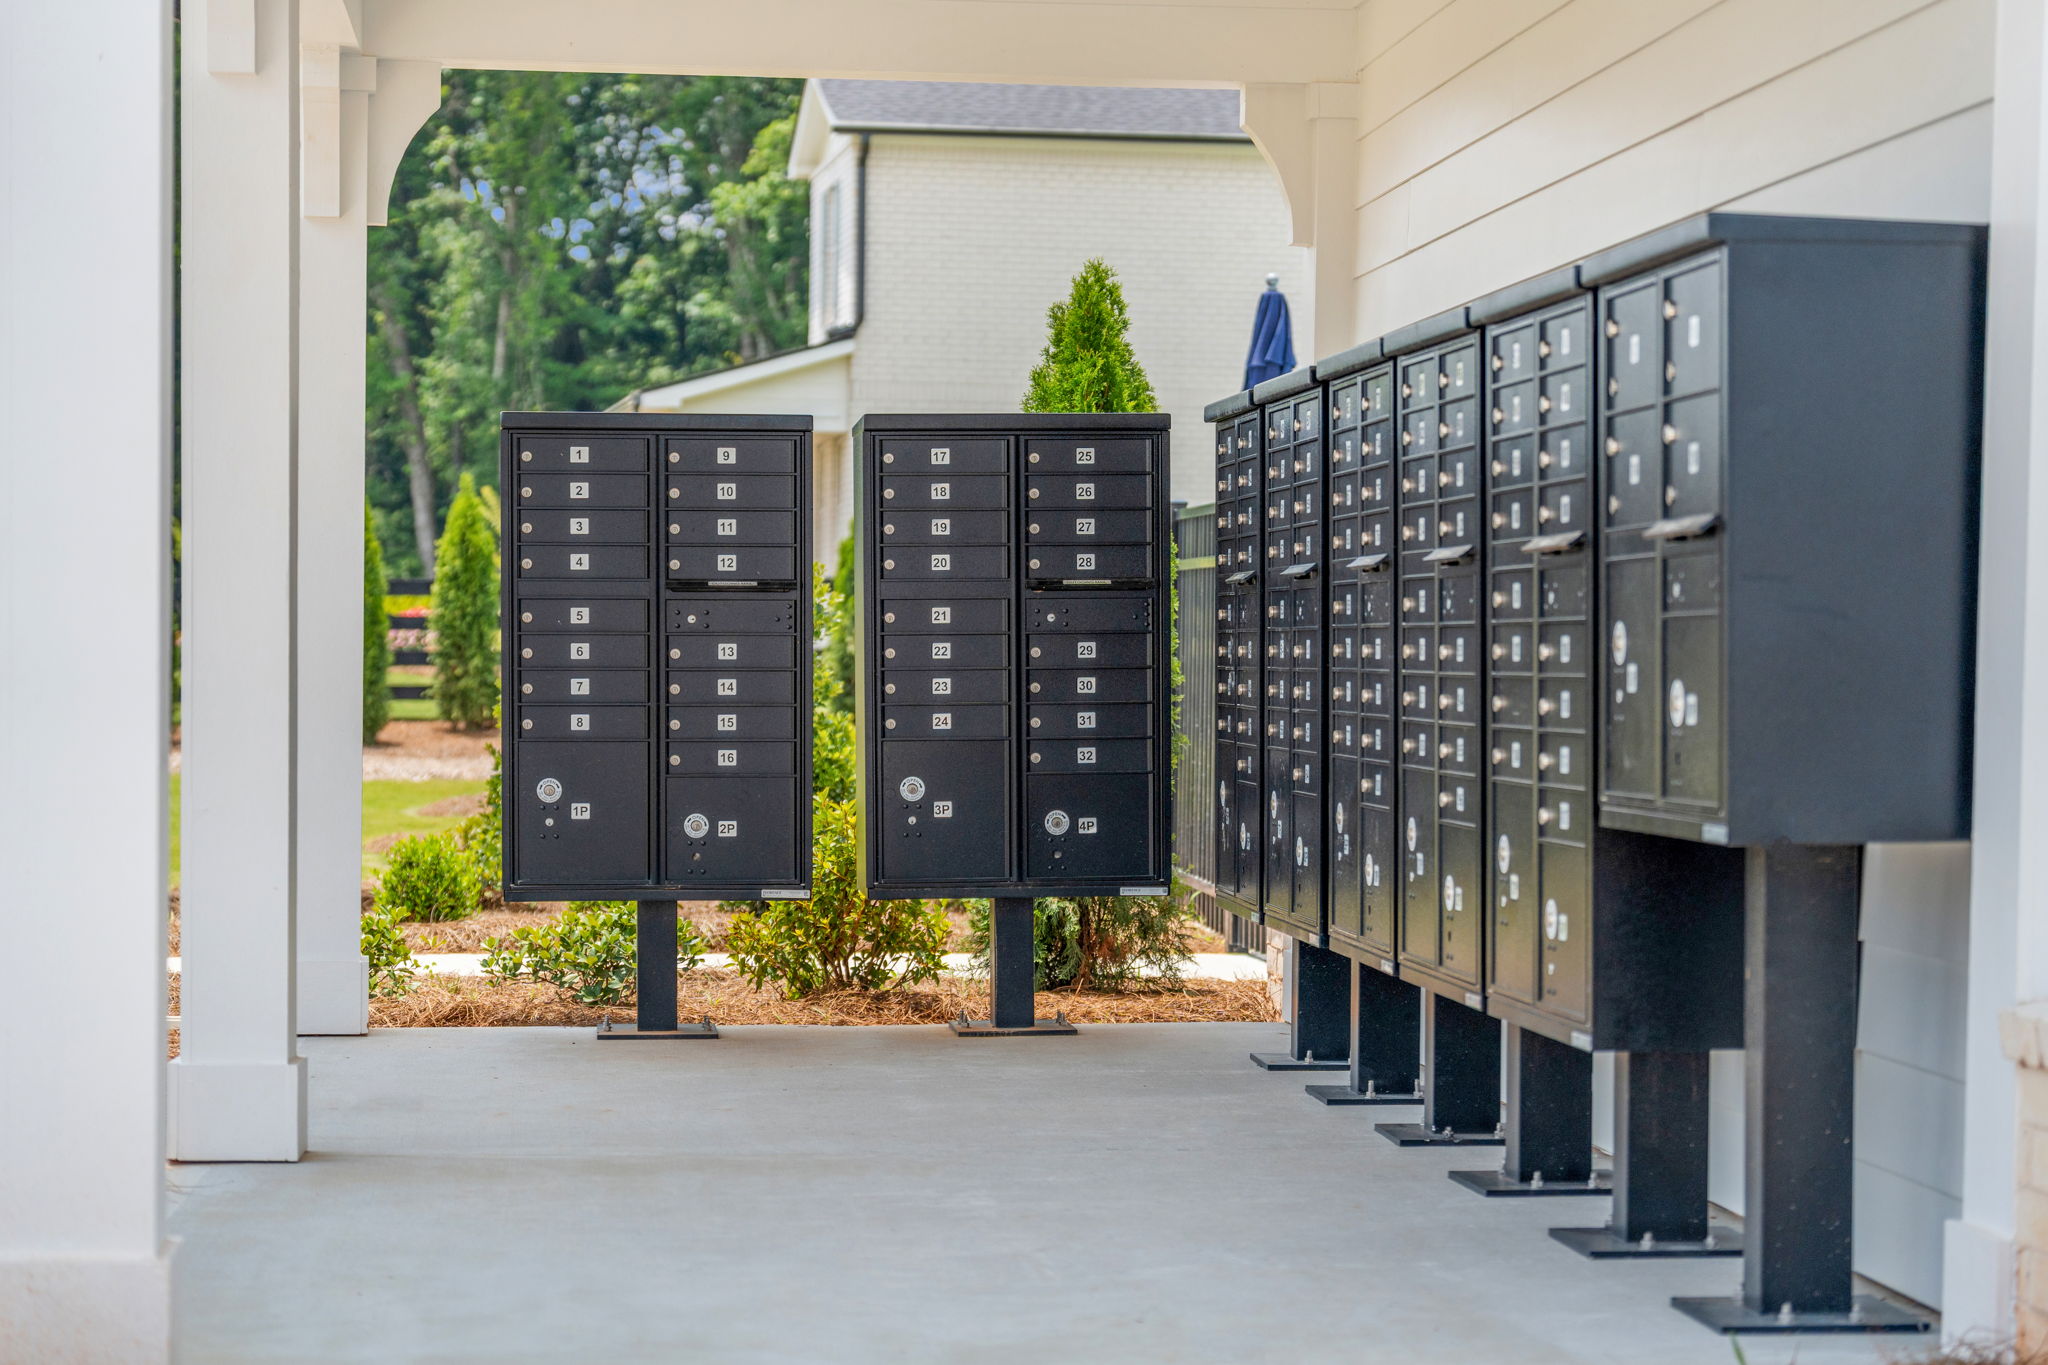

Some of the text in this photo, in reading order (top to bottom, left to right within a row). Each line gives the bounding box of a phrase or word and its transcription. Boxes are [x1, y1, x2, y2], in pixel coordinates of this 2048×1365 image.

[575, 449, 582, 461] 1
[722, 450, 730, 462] 9
[932, 451, 948, 463] 17
[1078, 450, 1093, 462] 25
[575, 484, 583, 496] 2
[719, 485, 734, 498] 10
[932, 486, 948, 498] 18
[1077, 486, 1093, 498] 26
[575, 520, 584, 532] 3
[719, 521, 733, 533] 11
[933, 521, 948, 533] 19
[1078, 521, 1093, 533] 27
[575, 556, 584, 568] 4
[719, 557, 734, 569] 12
[933, 557, 948, 569] 20
[1078, 556, 1093, 568] 28
[575, 610, 584, 622] 5
[933, 610, 947, 622] 21
[575, 645, 584, 657] 6
[720, 646, 735, 658] 13
[933, 645, 949, 657] 22
[1079, 644, 1094, 656] 29
[576, 681, 584, 693] 7
[719, 681, 735, 693] 14
[934, 680, 949, 692] 23
[1078, 679, 1094, 692] 30
[575, 716, 584, 728] 8
[719, 716, 735, 729] 15
[934, 716, 949, 727] 24
[1079, 714, 1092, 726] 31
[720, 752, 735, 764] 16
[1079, 750, 1094, 762] 32
[572, 805, 589, 817] 1P
[935, 804, 951, 816] 3P
[1048, 811, 1061, 819] OPEN
[719, 823, 736, 835] 2P
[1080, 820, 1095, 832] 4P
